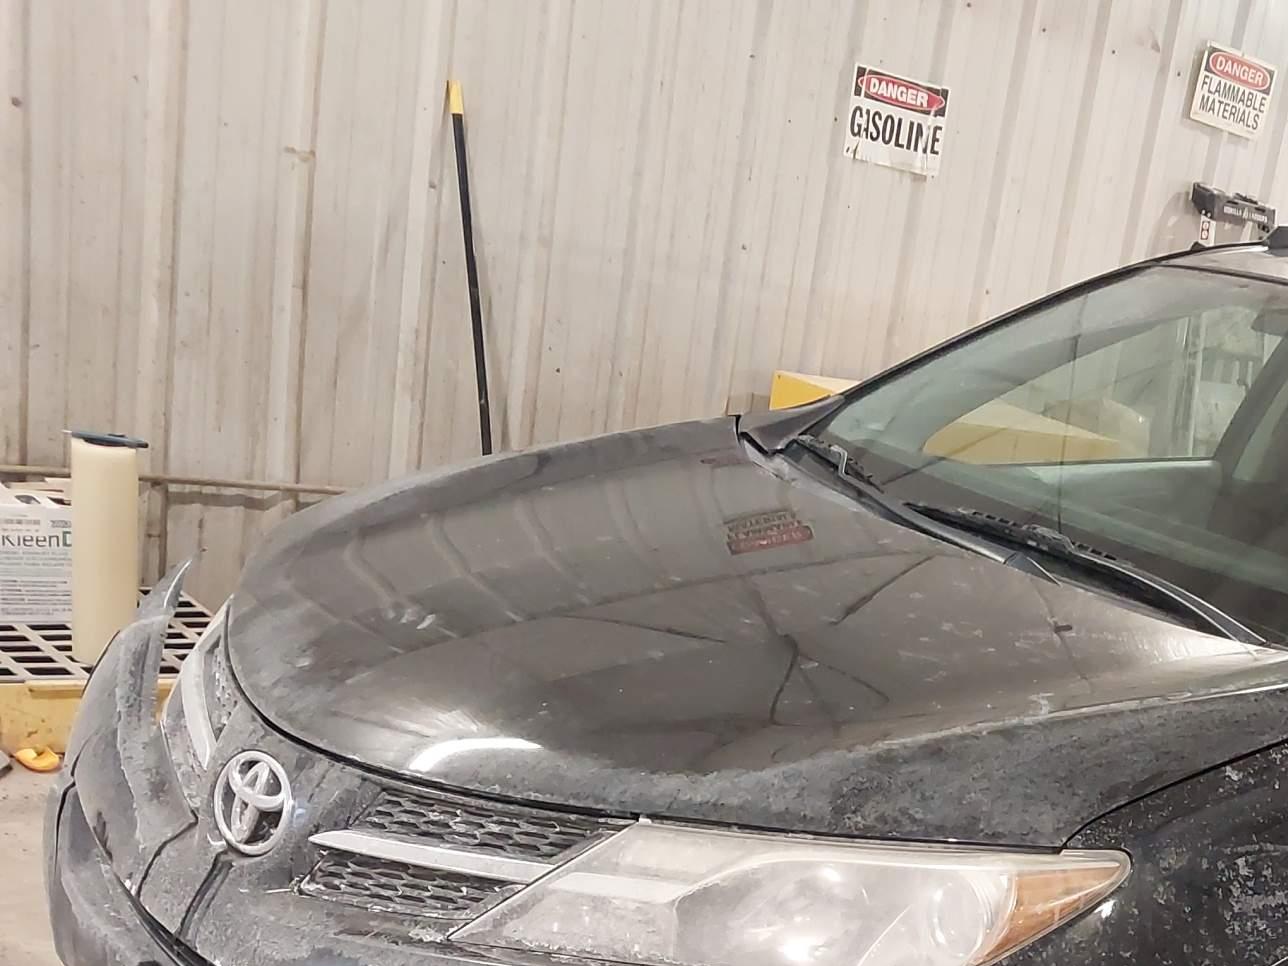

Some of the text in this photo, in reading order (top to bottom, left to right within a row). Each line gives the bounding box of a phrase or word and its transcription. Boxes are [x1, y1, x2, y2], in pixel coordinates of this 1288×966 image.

[1215, 55, 1264, 86] DANGER
[870, 77, 929, 108] DANGER
[1201, 75, 1267, 114] FLAMMABLE
[1199, 94, 1260, 130] MATERIALS
